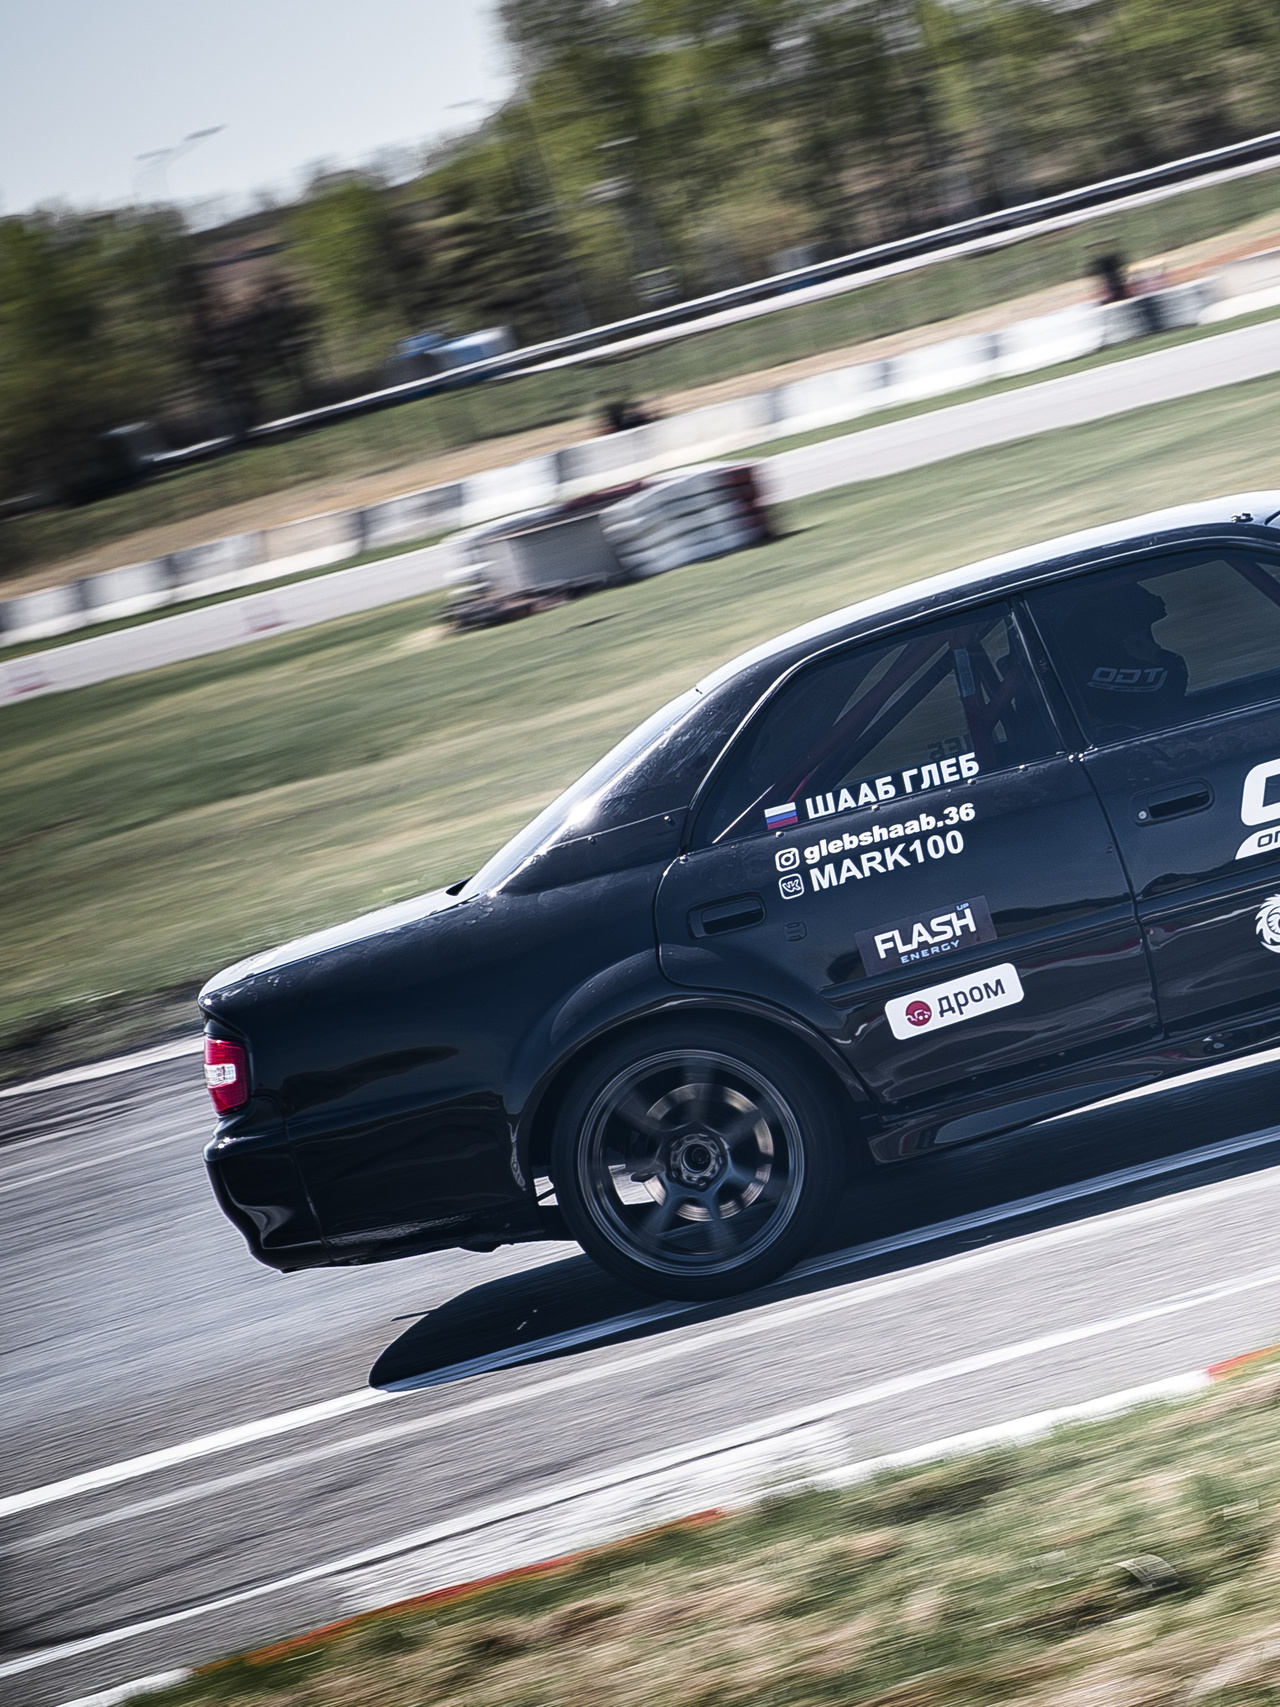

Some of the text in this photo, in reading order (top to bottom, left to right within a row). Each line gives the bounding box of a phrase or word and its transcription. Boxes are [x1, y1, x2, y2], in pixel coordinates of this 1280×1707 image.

[805, 752, 980, 820] ШААБ ГЛЕБ
[803, 802, 976, 865] glebshaab.36
[809, 830, 964, 892] MARK100
[874, 908, 977, 959] FLASH
[900, 939, 960, 964] ENERGY
[937, 978, 1006, 1018] дром
